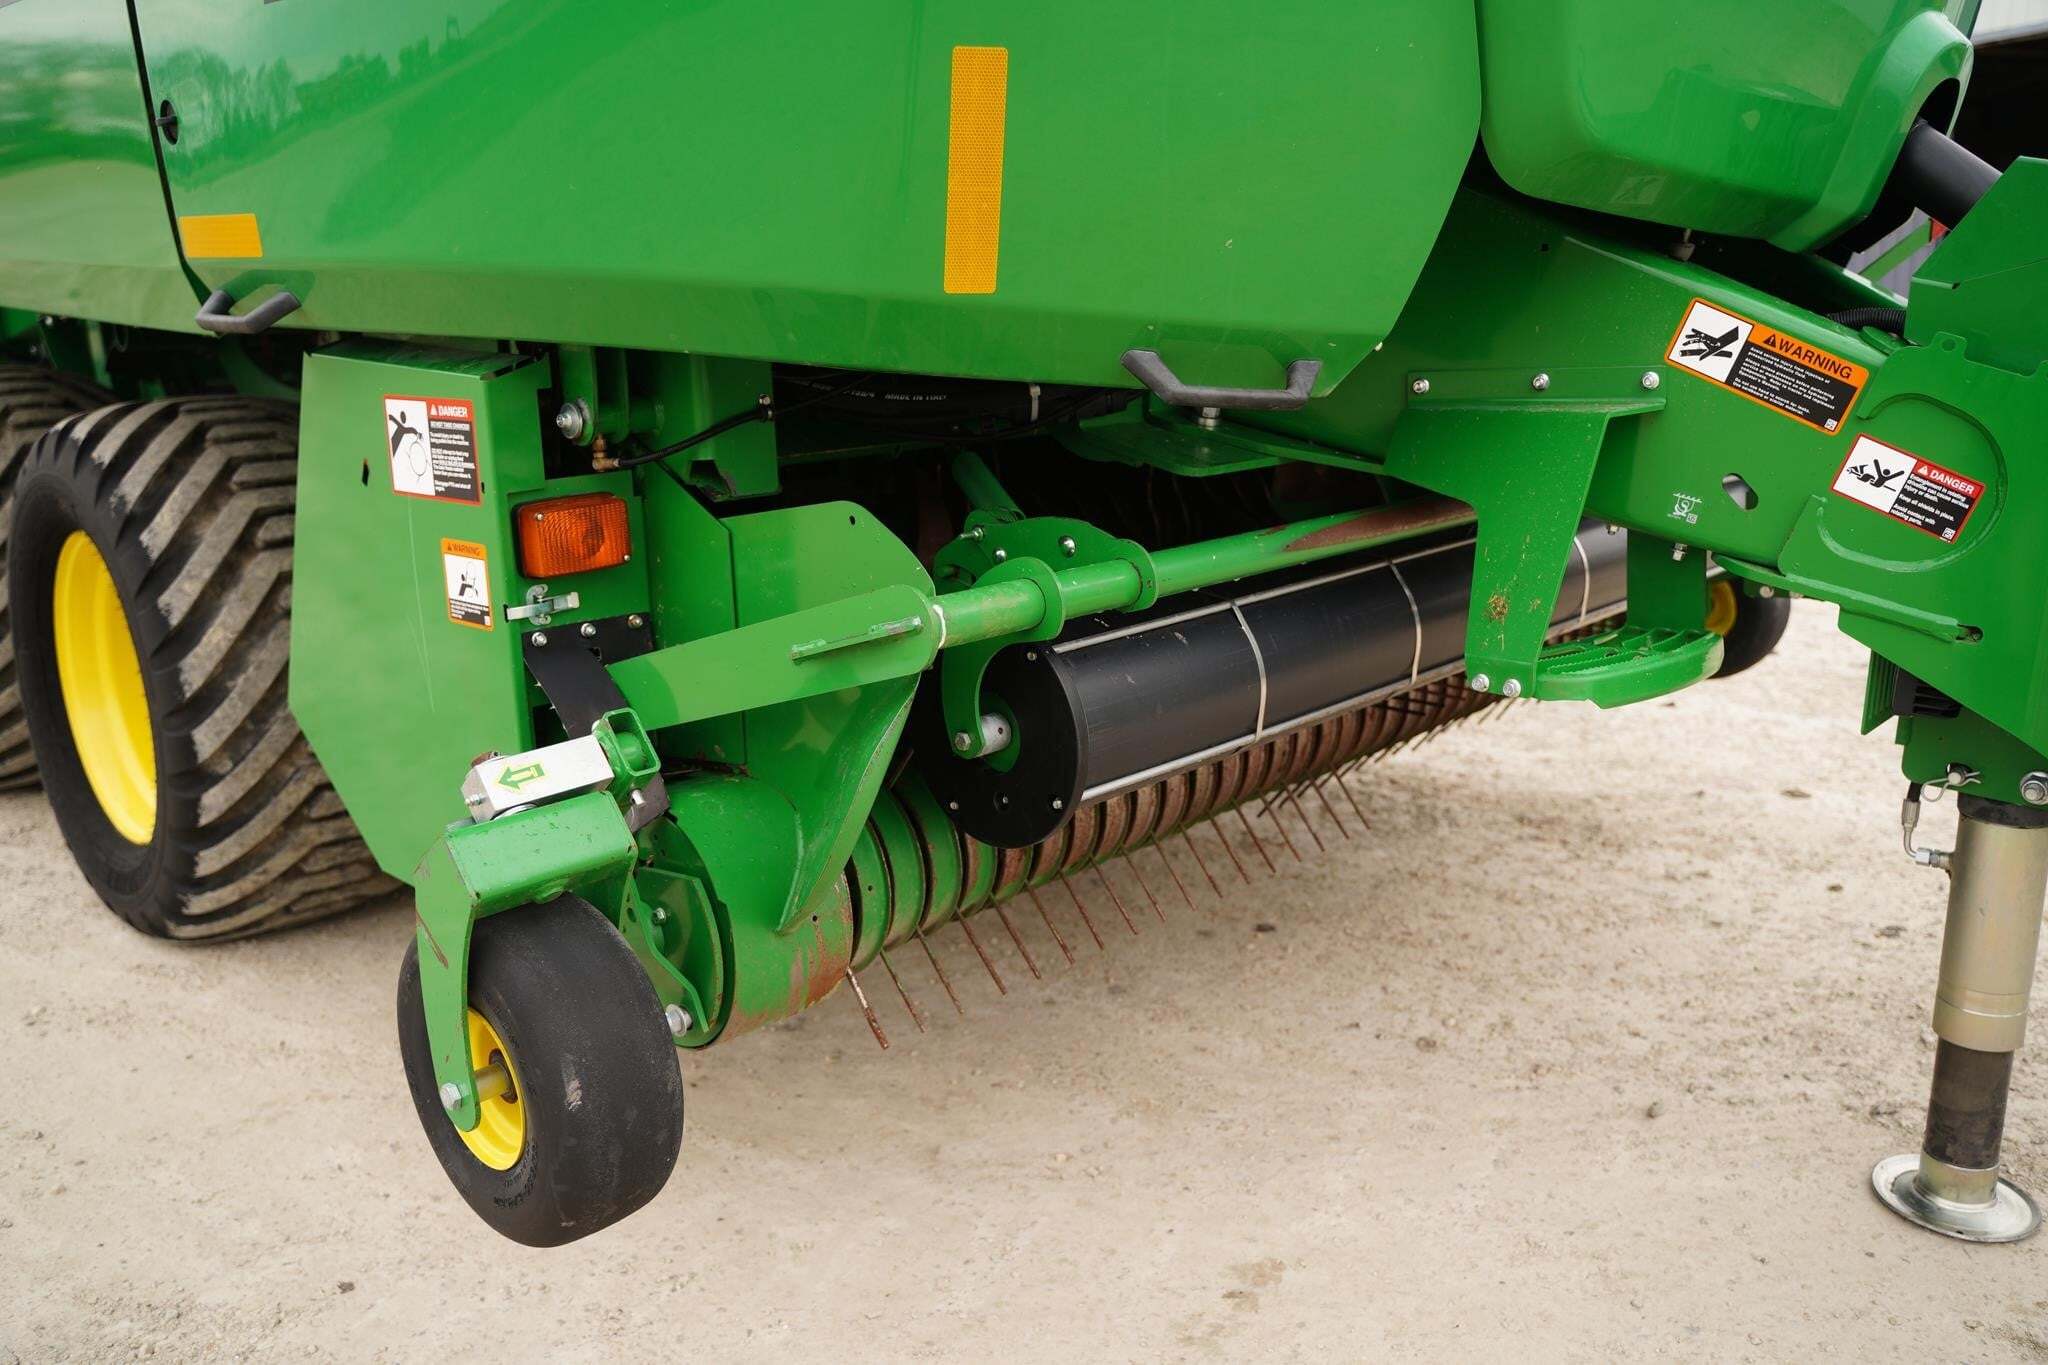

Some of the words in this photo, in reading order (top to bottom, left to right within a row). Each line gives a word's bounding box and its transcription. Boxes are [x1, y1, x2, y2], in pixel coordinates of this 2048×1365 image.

[1779, 338, 1853, 380] WARNING
[437, 404, 469, 418] DANGER
[1929, 470, 1974, 494] DANGER
[452, 544, 481, 557] WARNING
